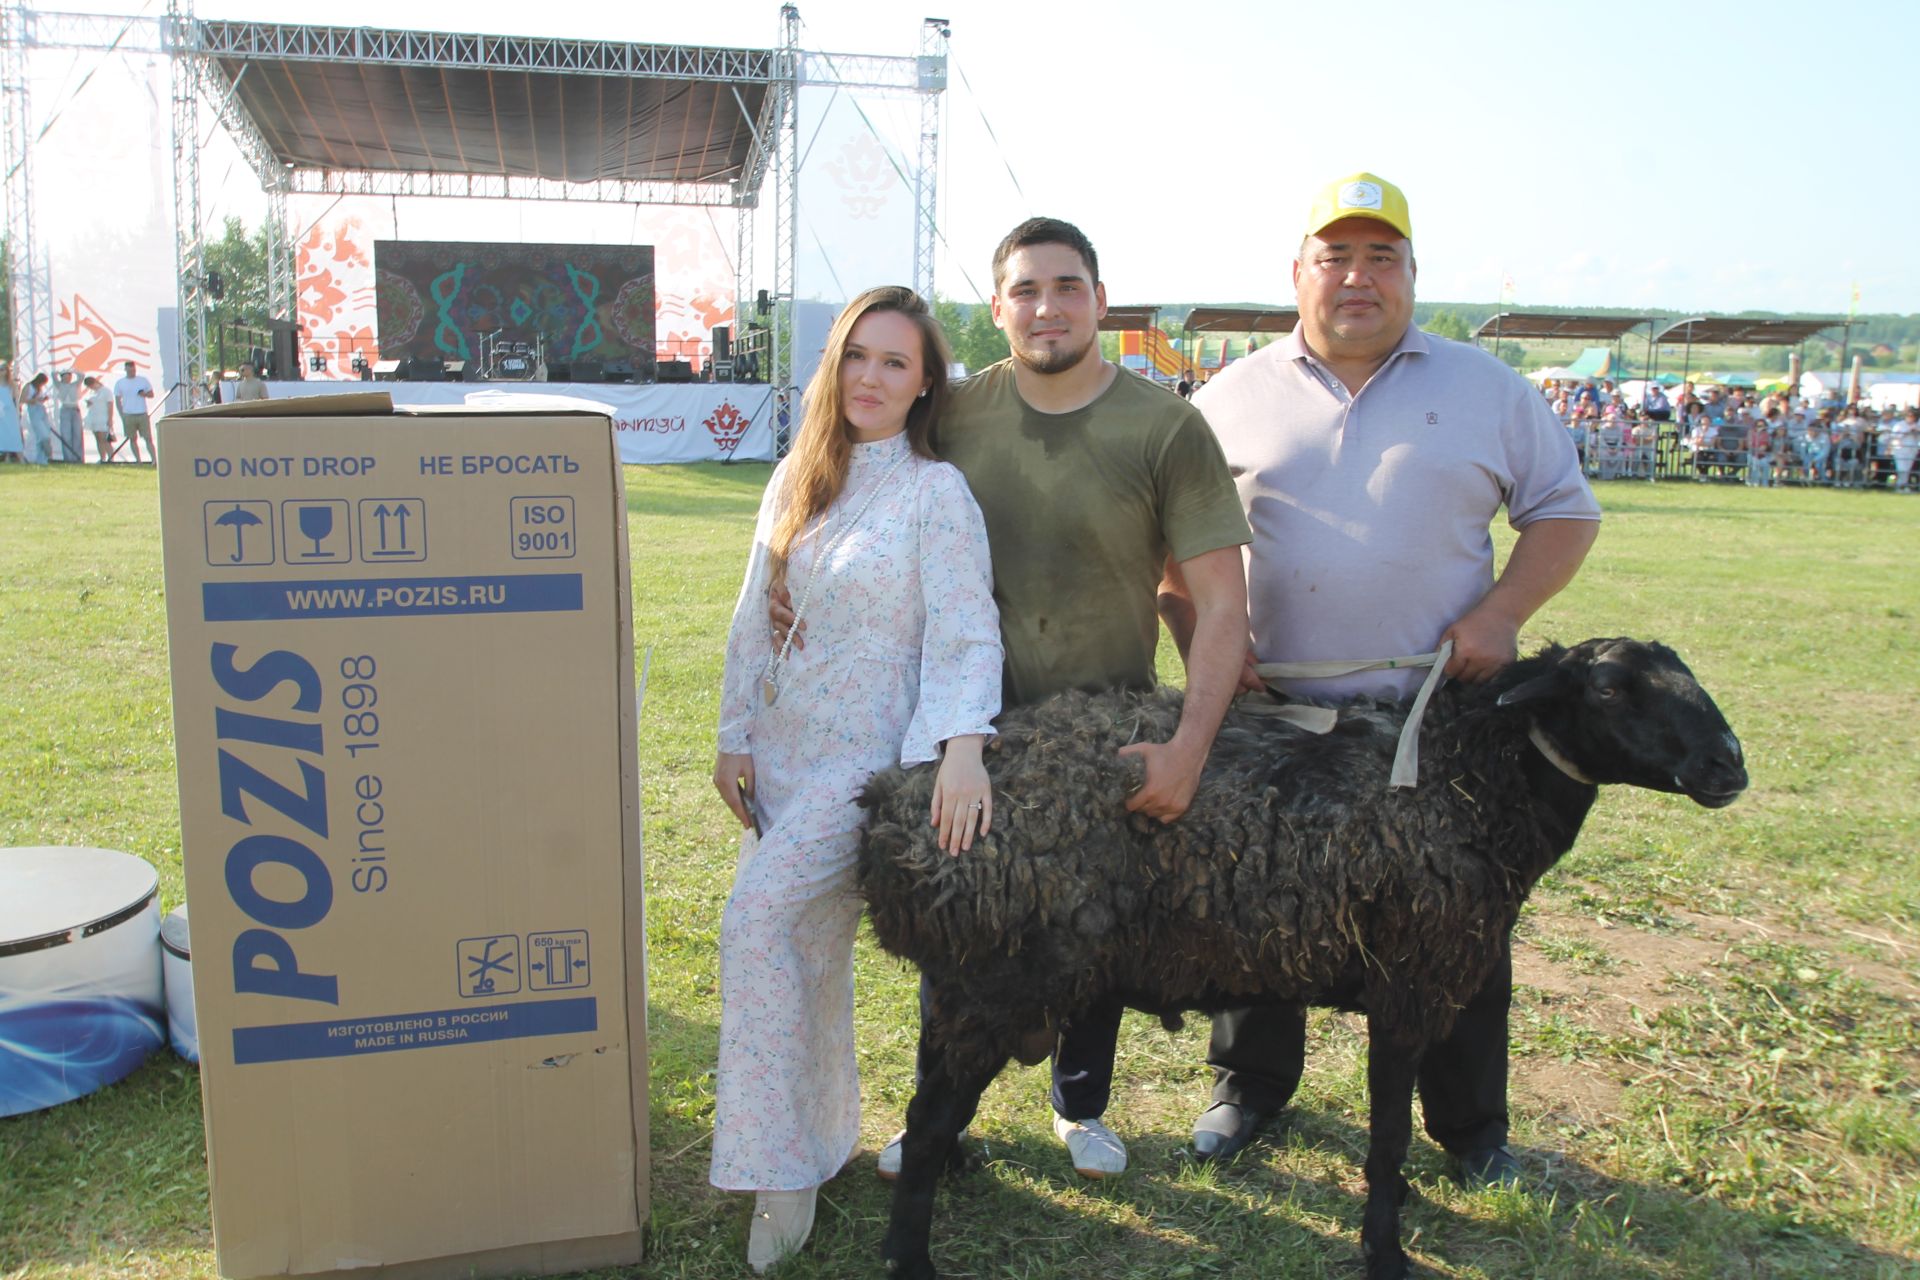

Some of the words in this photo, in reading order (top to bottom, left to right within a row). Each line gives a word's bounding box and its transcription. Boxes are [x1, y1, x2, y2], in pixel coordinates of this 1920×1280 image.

[194, 457, 232, 478] DO
[240, 456, 294, 478] NOT
[303, 456, 376, 478] DROP
[419, 455, 453, 476] НЕ
[461, 454, 580, 476] БРОСАТЬ
[523, 505, 566, 525] ISO
[517, 531, 571, 552] 9001
[286, 585, 507, 610] WWW.POZIS.RU
[339, 655, 380, 758] 1898
[210, 641, 338, 1005] POZIS
[351, 775, 387, 893] Since
[534, 937, 554, 947] 650
[327, 1018, 433, 1037] ИЗГОТОВЛЕНО
[438, 1017, 447, 1027] В
[451, 1010, 509, 1026] РОССИИ
[355, 1035, 396, 1049] MADE
[400, 1033, 414, 1044] IN
[418, 1028, 468, 1043] RUSSIA
